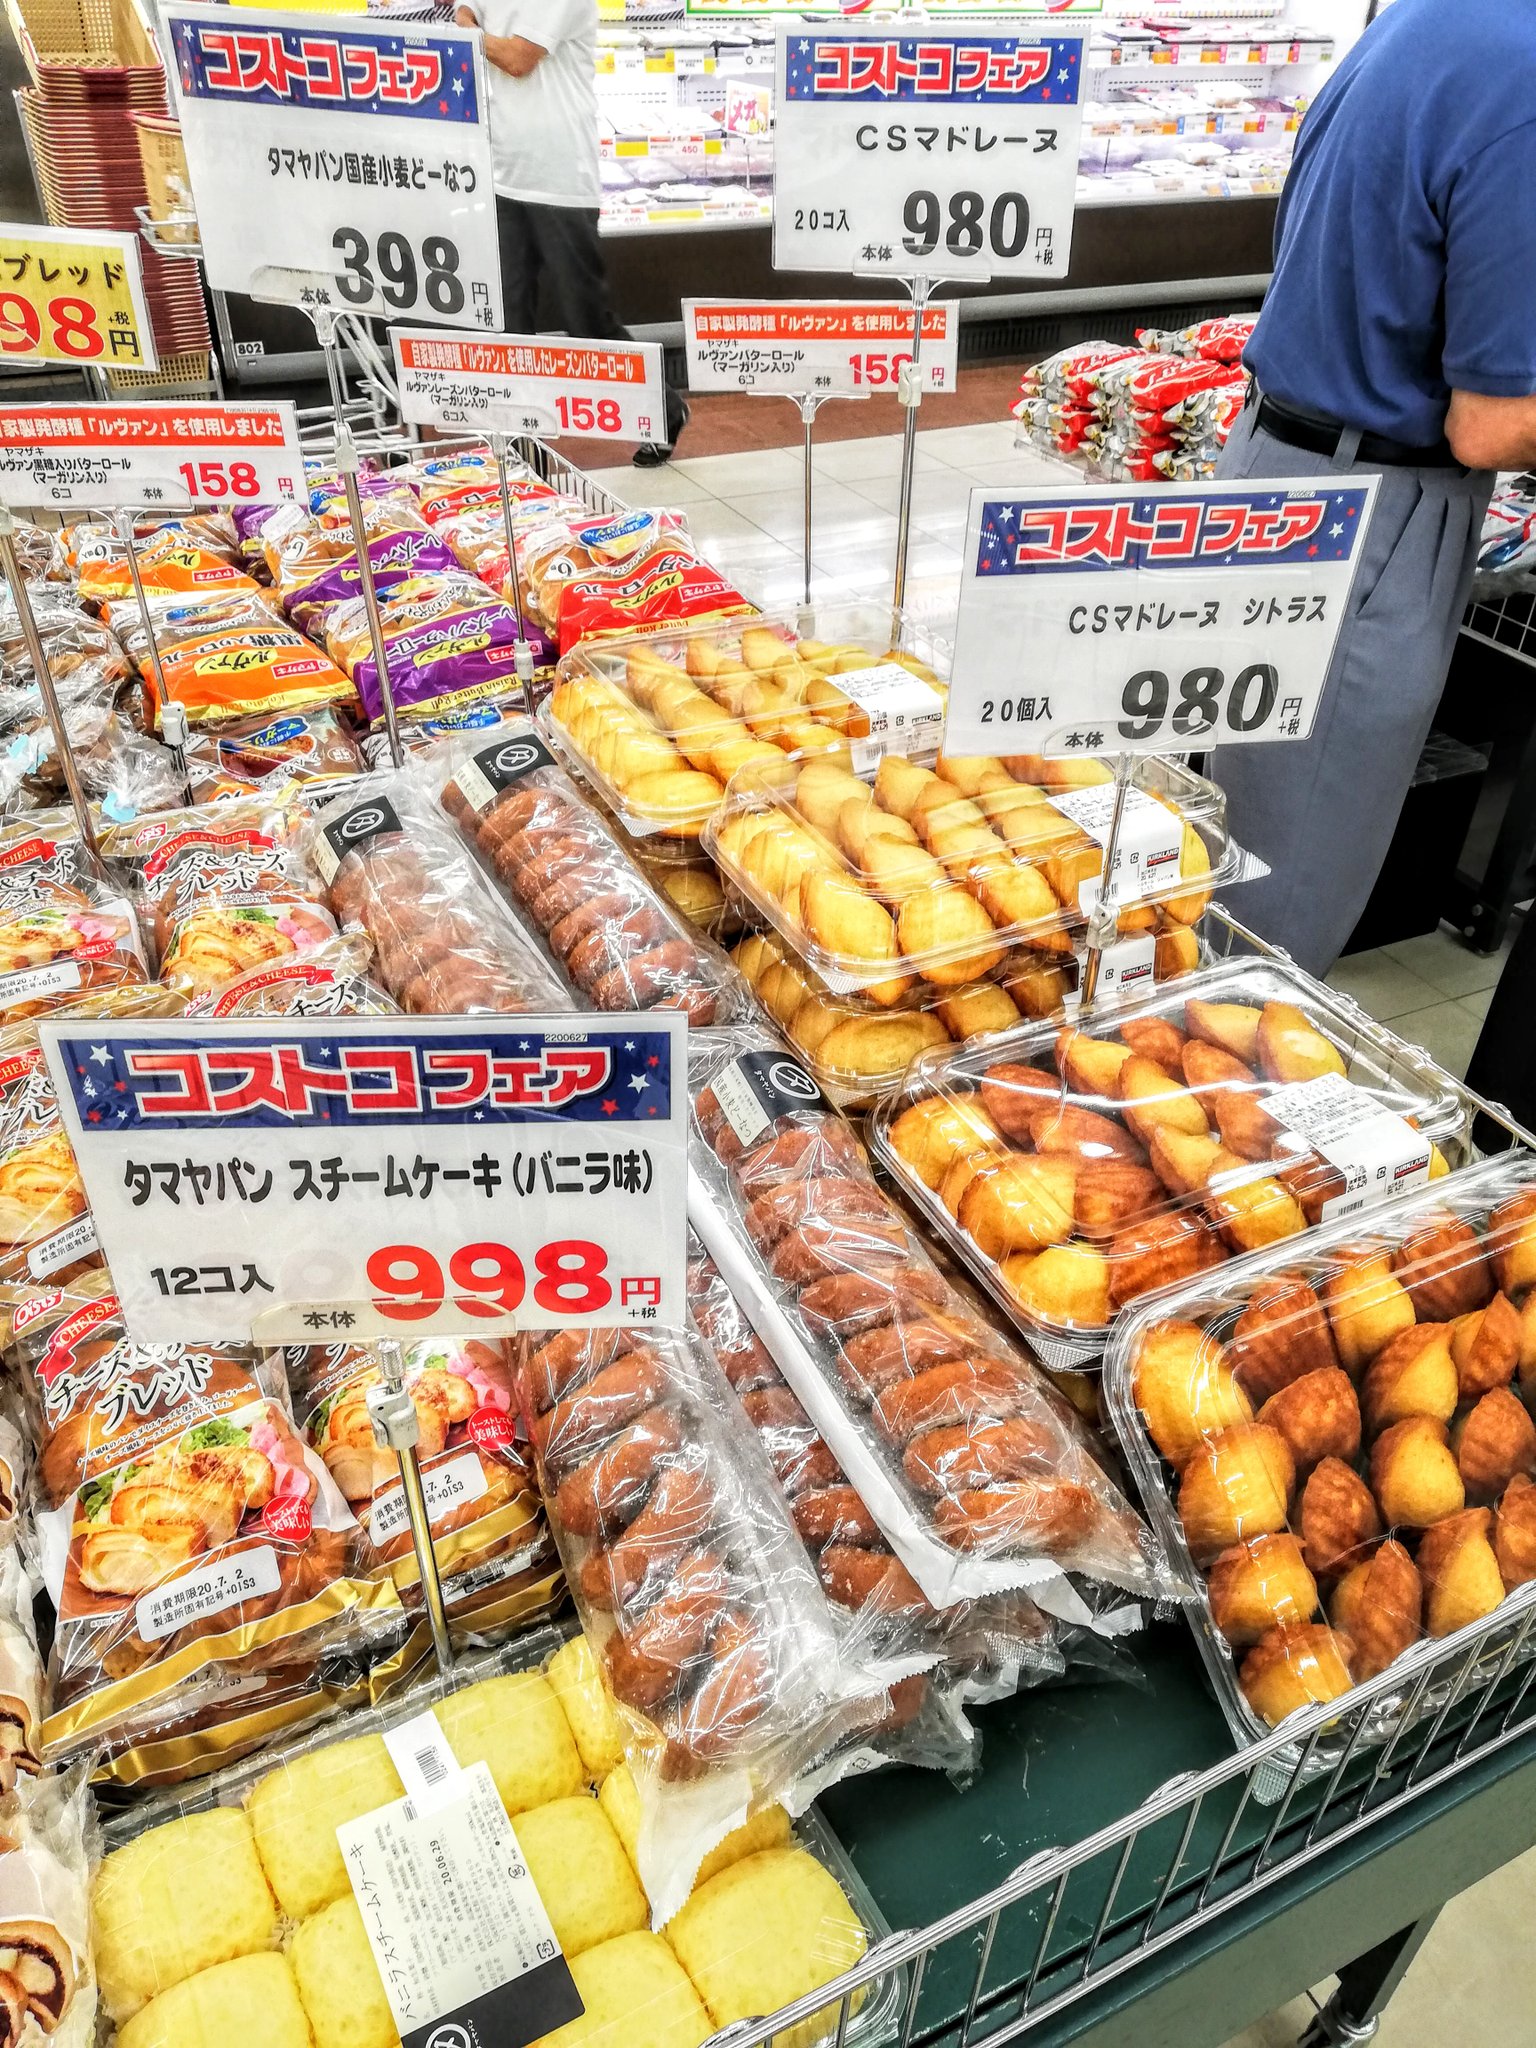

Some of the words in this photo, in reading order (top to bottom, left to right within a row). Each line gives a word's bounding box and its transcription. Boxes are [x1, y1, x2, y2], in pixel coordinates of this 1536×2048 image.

[202, 31, 441, 104] コストコフェア
[814, 41, 1052, 96] コストコフェア
[856, 124, 1058, 152] CSマドレーヌ
[268, 147, 477, 194] タマヤパン国産小麦どーなつ
[795, 209, 850, 231] 20コ入
[862, 244, 892, 261] 本体
[902, 190, 1030, 258] 980
[1035, 227, 1053, 247] 円
[300, 286, 331, 304] 本体
[332, 227, 465, 314] 398
[472, 282, 489, 305] 円
[1035, 249, 1053, 265] +税
[0, 253, 123, 289] ブレッド
[108, 311, 130, 325] +税
[475, 309, 494, 327] +税
[109, 329, 140, 357] 円
[238, 344, 262, 354] 802
[698, 349, 804, 361] ルヴァンバターロール
[406, 381, 511, 399] ルヴァンレーズンバターロール
[414, 371, 446, 382] ヤマザキ
[815, 376, 831, 387] 本体
[932, 367, 944, 380] 円
[0, 416, 283, 438] 家製発酵種「ルヴァン」を使用しました
[443, 411, 468, 423] 6コ入
[522, 416, 539, 429] 本体
[556, 396, 622, 433] 158
[638, 416, 651, 431] 円
[5, 447, 44, 456] ヤマザキ
[52, 487, 72, 499] 6コ
[143, 487, 163, 499] 本体
[179, 462, 261, 497] 158
[278, 478, 294, 492] 円
[1015, 501, 1327, 565] コストコフェア
[1069, 601, 1221, 635] CSマドレーヌ
[1243, 595, 1327, 626] シトラス
[199, 650, 271, 671] ルヴァン
[276, 662, 318, 677] ヤマザキ
[981, 696, 1053, 723] 20個入
[1065, 731, 1104, 748] 本体
[1117, 663, 1280, 740] 980
[1280, 697, 1302, 718] 円
[1278, 718, 1300, 735] +税
[545, 1033, 588, 1042] 2200627
[124, 1044, 615, 1120] コストコフェア
[124, 1157, 273, 1206] タマヤパン
[288, 1149, 655, 1202] スチームケーキ(バニラ味)
[150, 1263, 275, 1296] 12コ入
[302, 1310, 356, 1330] 本体
[365, 1239, 613, 1321] 998
[620, 1276, 661, 1306] 円
[627, 1307, 657, 1319] +税
[100, 1355, 212, 1435] ブレッド
[444, 1474, 453, 1485] 2
[235, 1568, 244, 1580] 2
[152, 1590, 225, 1628] 製造所固有記号
[429, 1838, 453, 1886] 20.06.29
[350, 1843, 418, 2020] バニラスチームケーキ
